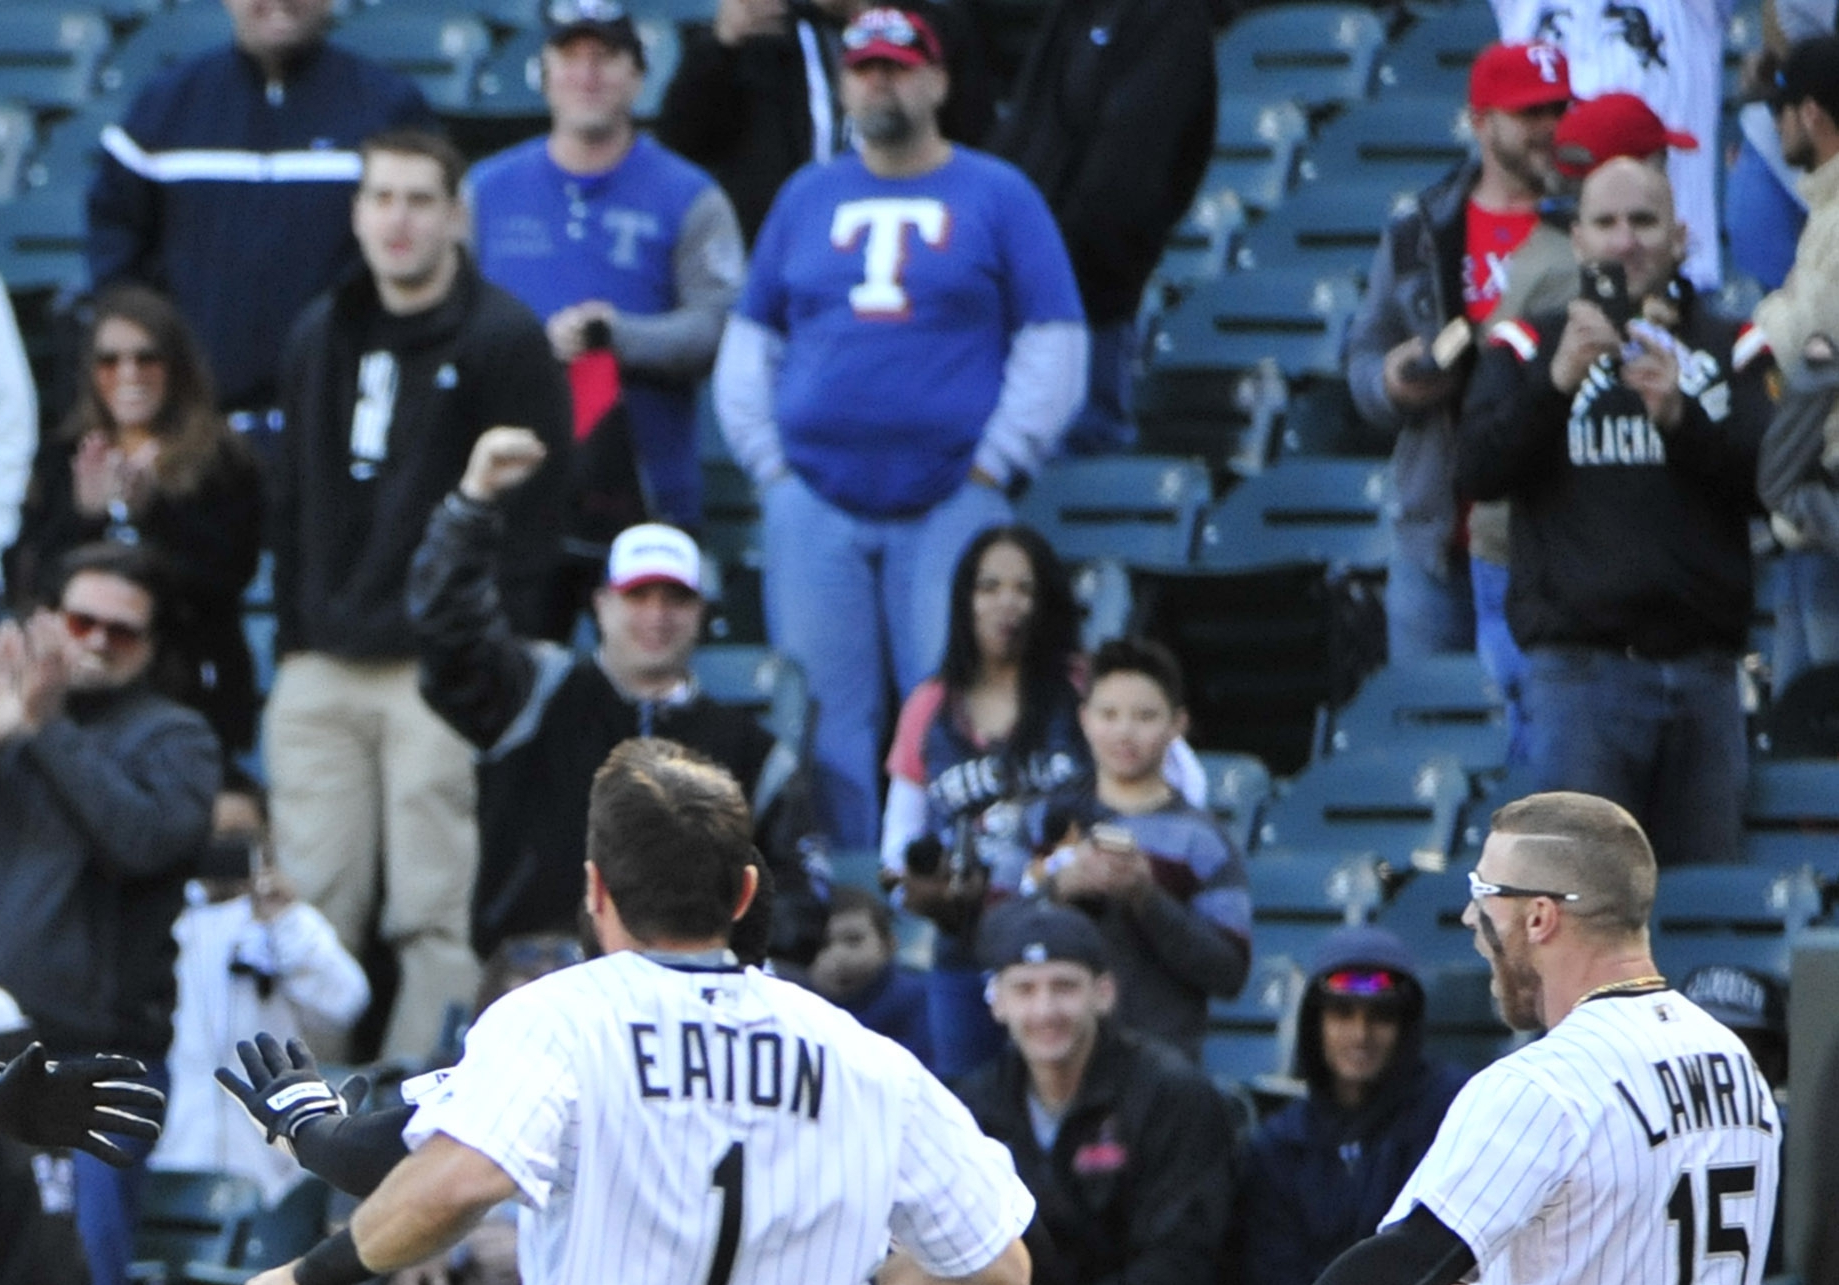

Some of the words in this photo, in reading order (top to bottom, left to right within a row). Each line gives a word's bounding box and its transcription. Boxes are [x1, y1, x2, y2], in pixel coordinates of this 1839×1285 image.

[1527, 46, 1558, 83] T
[601, 208, 658, 270] T
[830, 198, 951, 320] T
[627, 1021, 826, 1122] EATON
